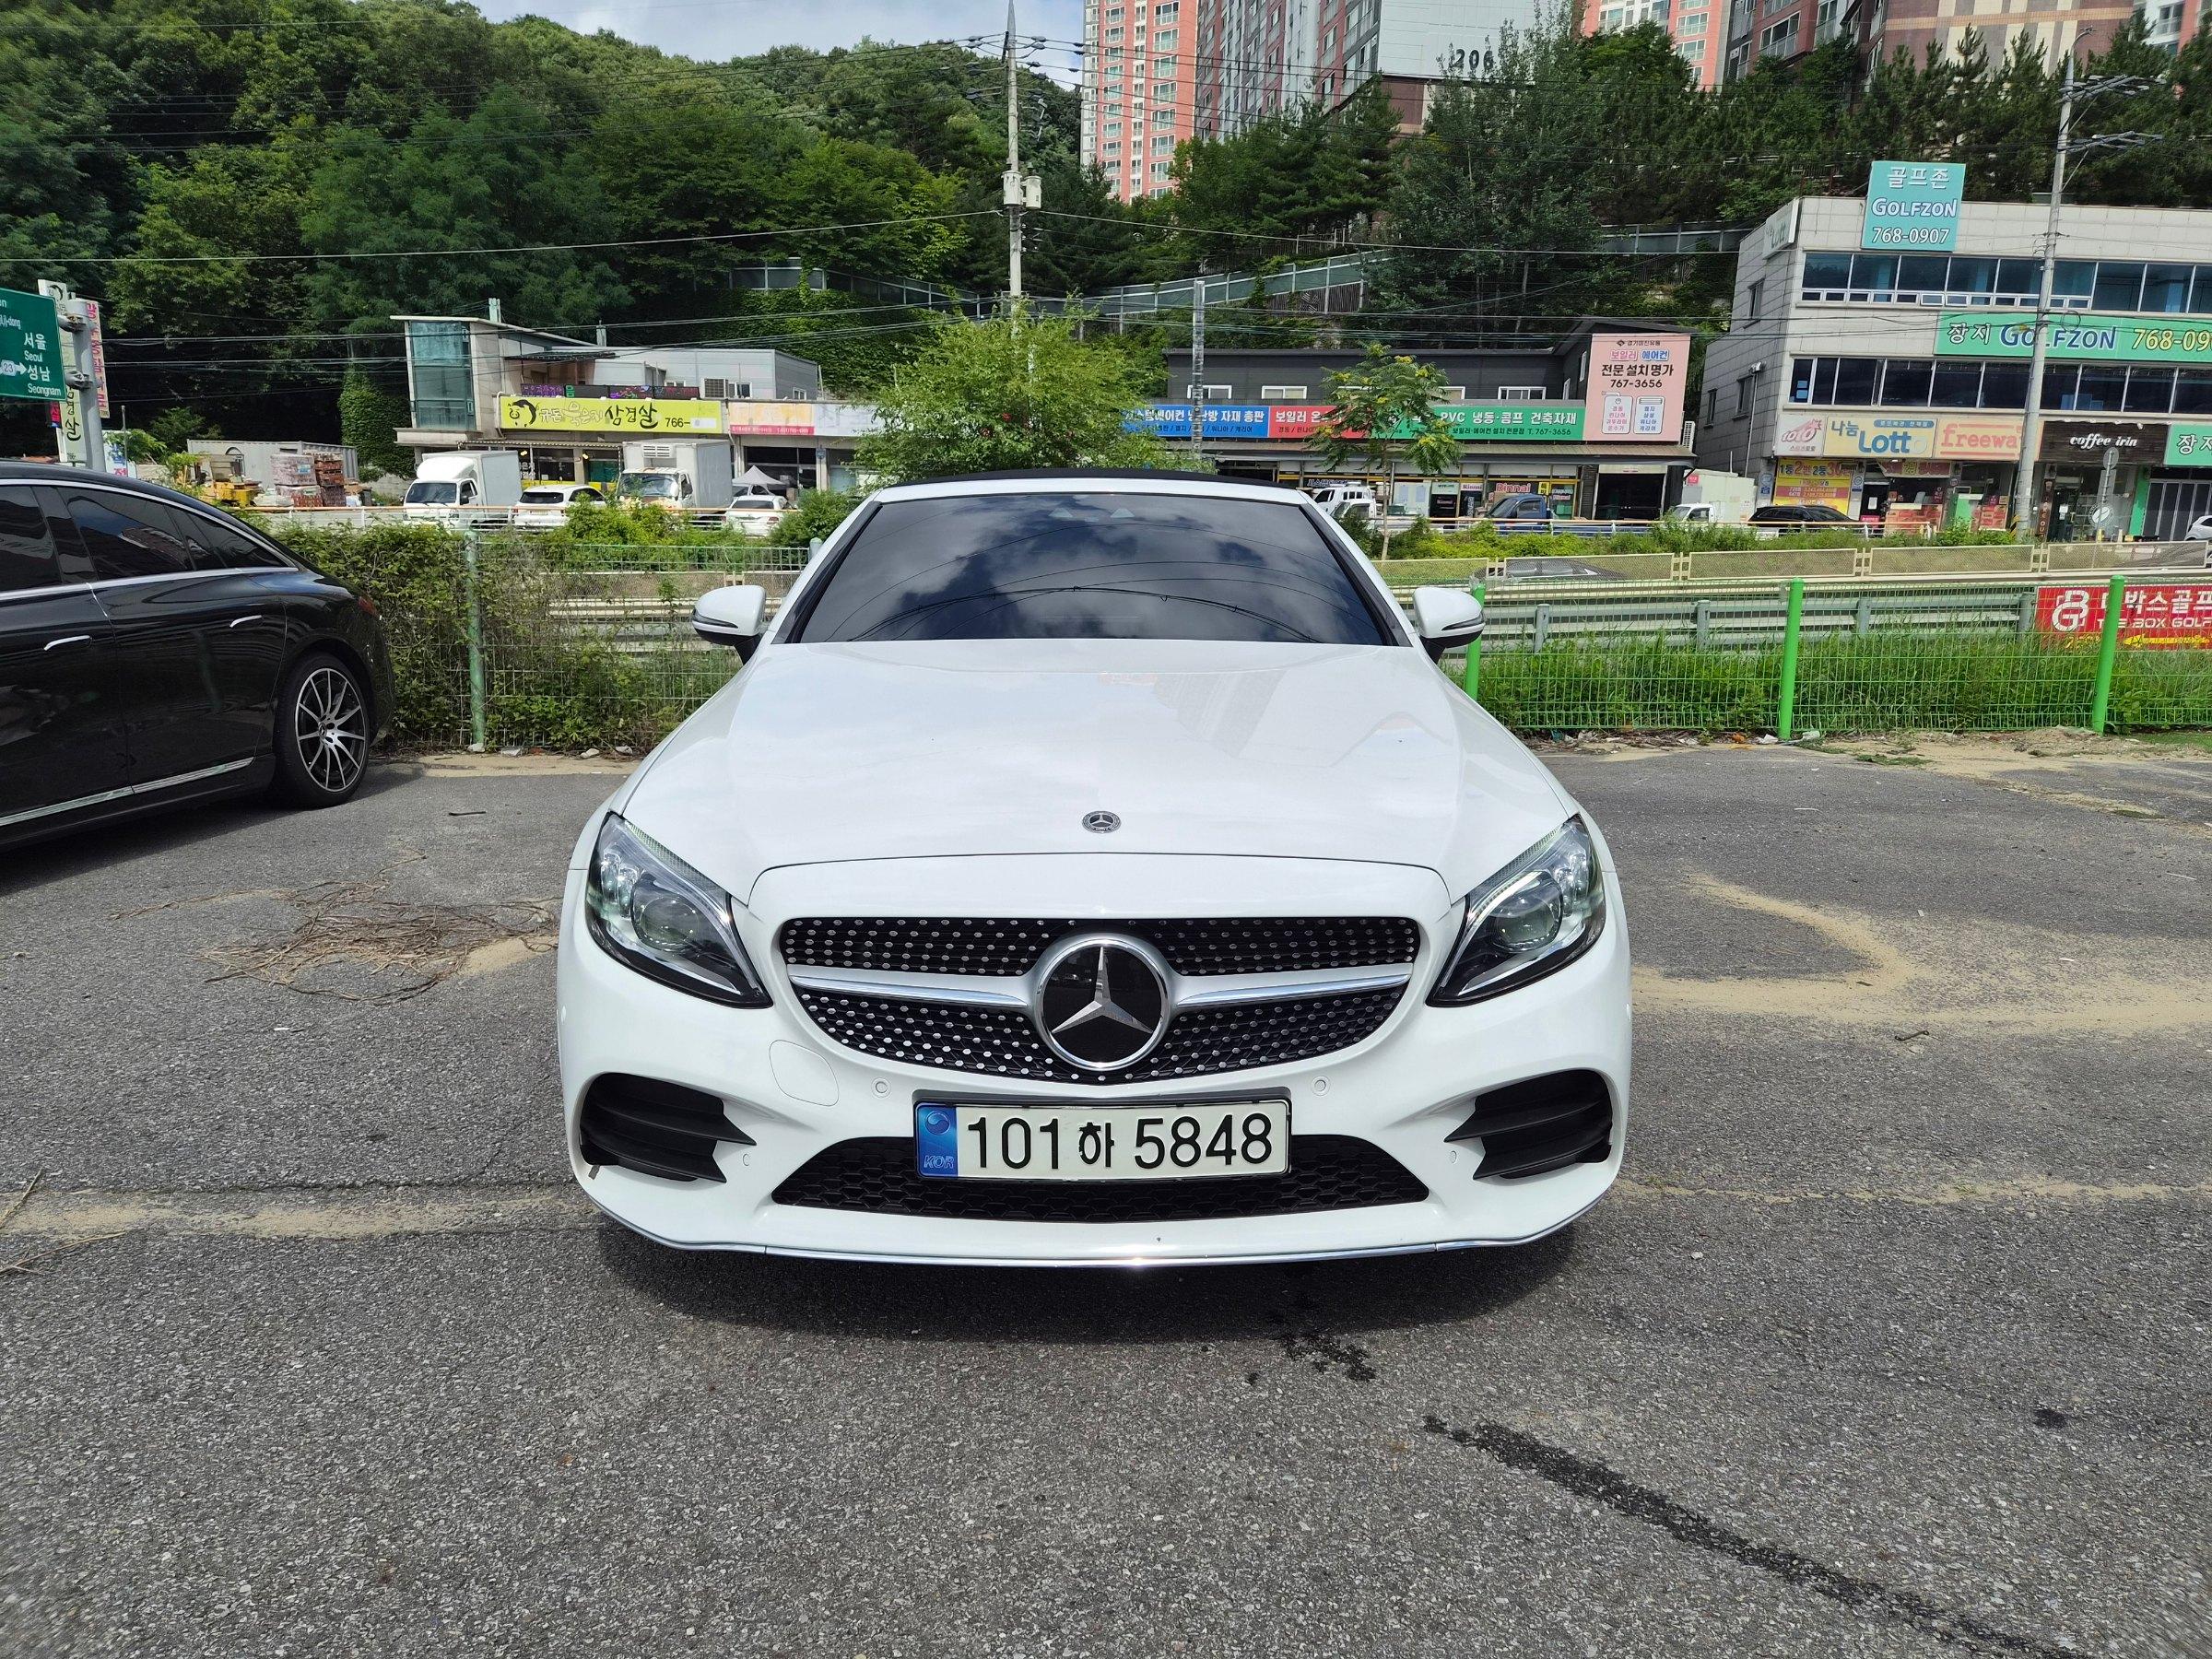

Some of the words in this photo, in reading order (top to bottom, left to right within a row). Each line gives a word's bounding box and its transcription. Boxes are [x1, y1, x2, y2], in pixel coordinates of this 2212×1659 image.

[1887, 166, 1949, 189] 골프존
[1871, 196, 1958, 218] GOLFZON
[1871, 226, 1951, 244] 768-0907
[24, 332, 46, 350] 서울
[1947, 322, 1992, 345] 장지
[1999, 323, 2117, 350] GOFZON
[2131, 327, 2212, 352] 768-09
[24, 350, 43, 362] Seoul
[1610, 350, 1638, 360] 보일러
[1641, 350, 1669, 360] 에어컨
[4, 362, 14, 372] 23
[28, 364, 50, 382] 성남
[1601, 364, 1624, 377] 전문
[1627, 364, 1649, 377] 설치
[1651, 364, 1674, 377] 명가
[28, 382, 62, 396] Seongnam
[1610, 379, 1663, 388] 767-3656
[605, 402, 658, 429] 삼겹살
[1220, 410, 1241, 423] 자재
[1244, 410, 1265, 423] 총판
[1276, 410, 1307, 423] 보일러
[1440, 411, 1465, 423] PVC
[1531, 411, 1577, 425] 건축자재
[1830, 420, 1860, 437] 나눔
[1940, 423, 2022, 449] freewa
[2069, 433, 2112, 450] coffee
[2115, 436, 2138, 448] irin
[1495, 482, 1532, 493] Rinnai
[2096, 618, 2126, 629] TE
[968, 1116, 1114, 1170] 101하
[1135, 1112, 1273, 1170] 5848
[924, 1154, 955, 1169] KOR
